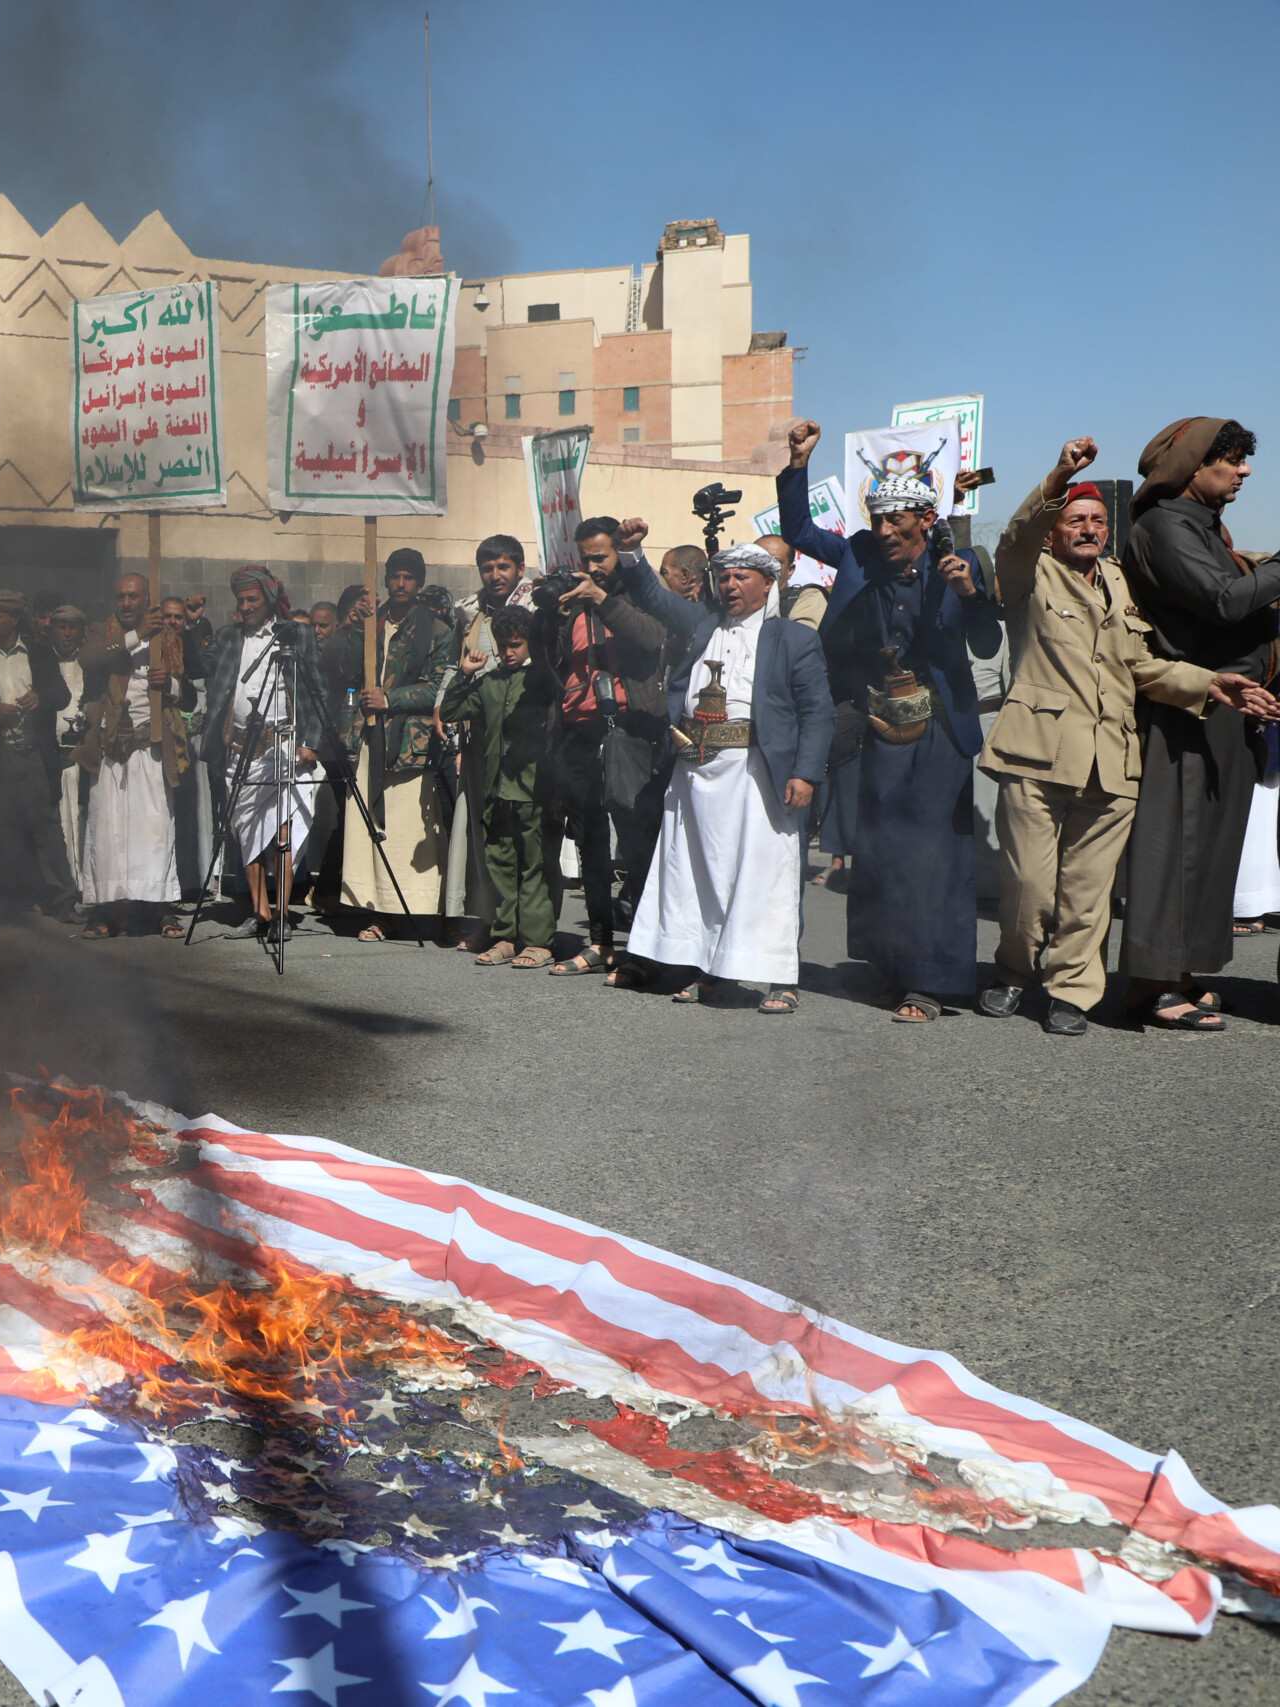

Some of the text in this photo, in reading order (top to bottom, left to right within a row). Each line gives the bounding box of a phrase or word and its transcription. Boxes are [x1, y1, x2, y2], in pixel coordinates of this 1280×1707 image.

[81, 290, 205, 348] الله أكبر
[303, 292, 438, 342] قاطعوا
[82, 336, 205, 376] الموت لأمريكا
[300, 345, 431, 390] البضائع الأمريكية
[82, 374, 206, 414] الموت لإسرائيل
[356, 398, 366, 428] و
[82, 410, 208, 450] اللعنة على اليهود
[85, 444, 211, 493] النصر للإسلام
[295, 440, 426, 481] الإسرائيلية
